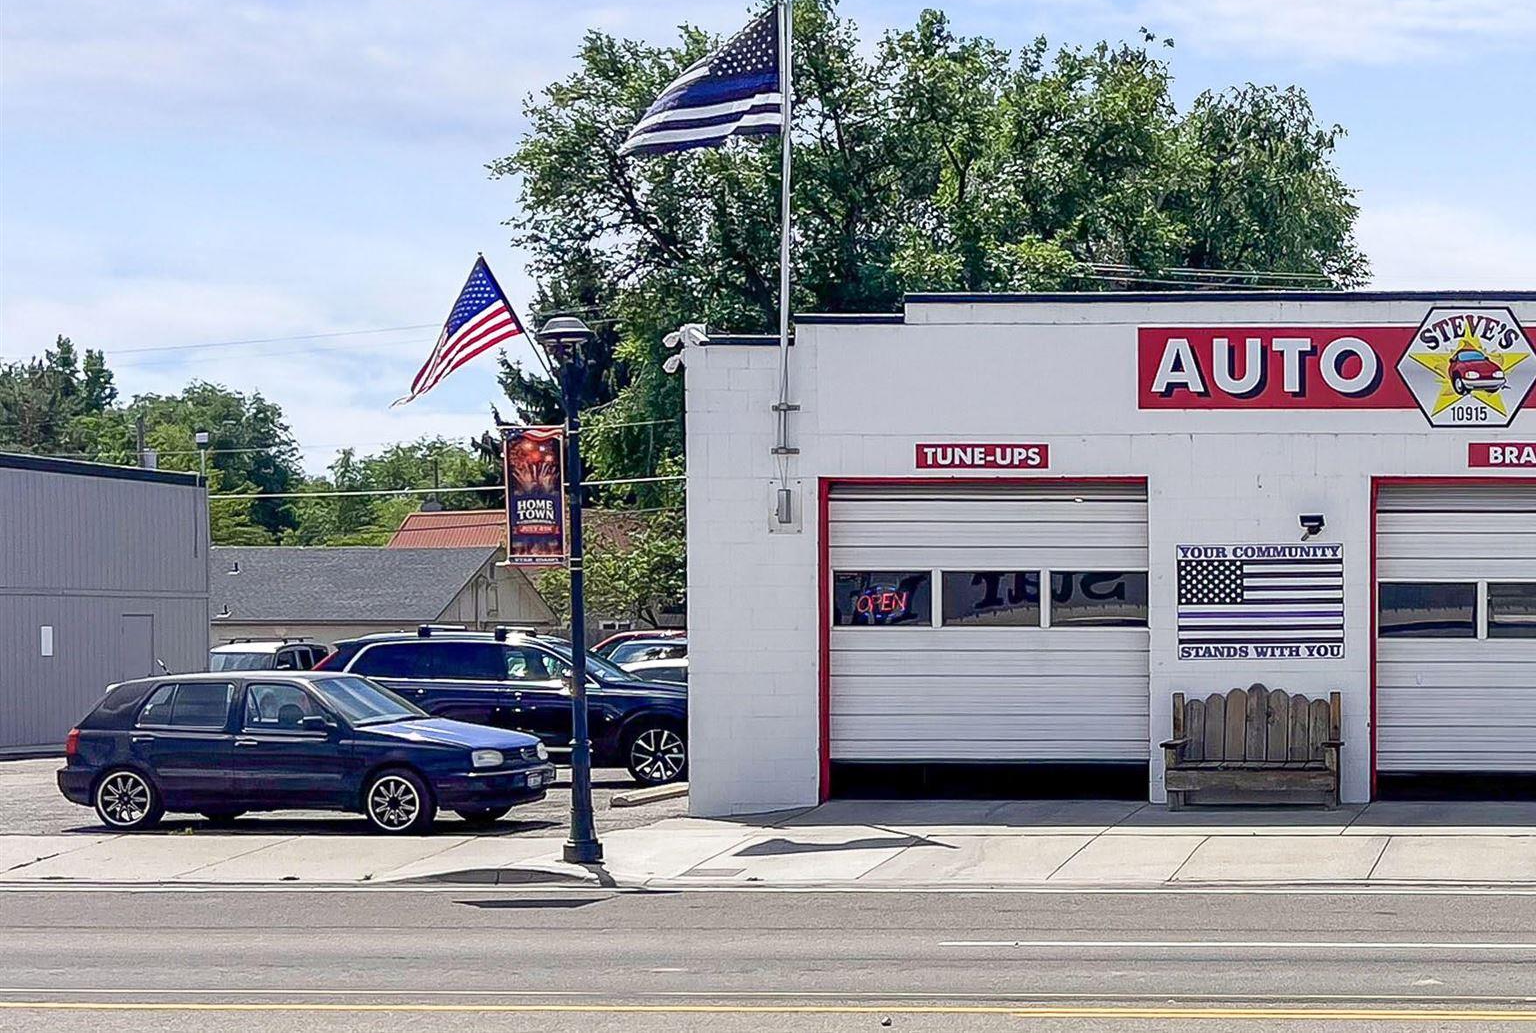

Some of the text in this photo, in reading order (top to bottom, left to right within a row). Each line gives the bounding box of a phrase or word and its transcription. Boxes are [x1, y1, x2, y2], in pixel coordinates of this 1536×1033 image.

[1419, 314, 1520, 350] STEVE'S
[1151, 336, 1383, 398] AUTO
[1451, 407, 1488, 422] 10915
[923, 447, 1042, 466] TUNE-UPS
[517, 499, 554, 510] HOME
[516, 509, 554, 520] TOWN
[1178, 545, 1340, 559] YOUR COMMUNITY
[857, 591, 907, 613] OPEN
[1181, 645, 1342, 658] STANDS WITH YOU
